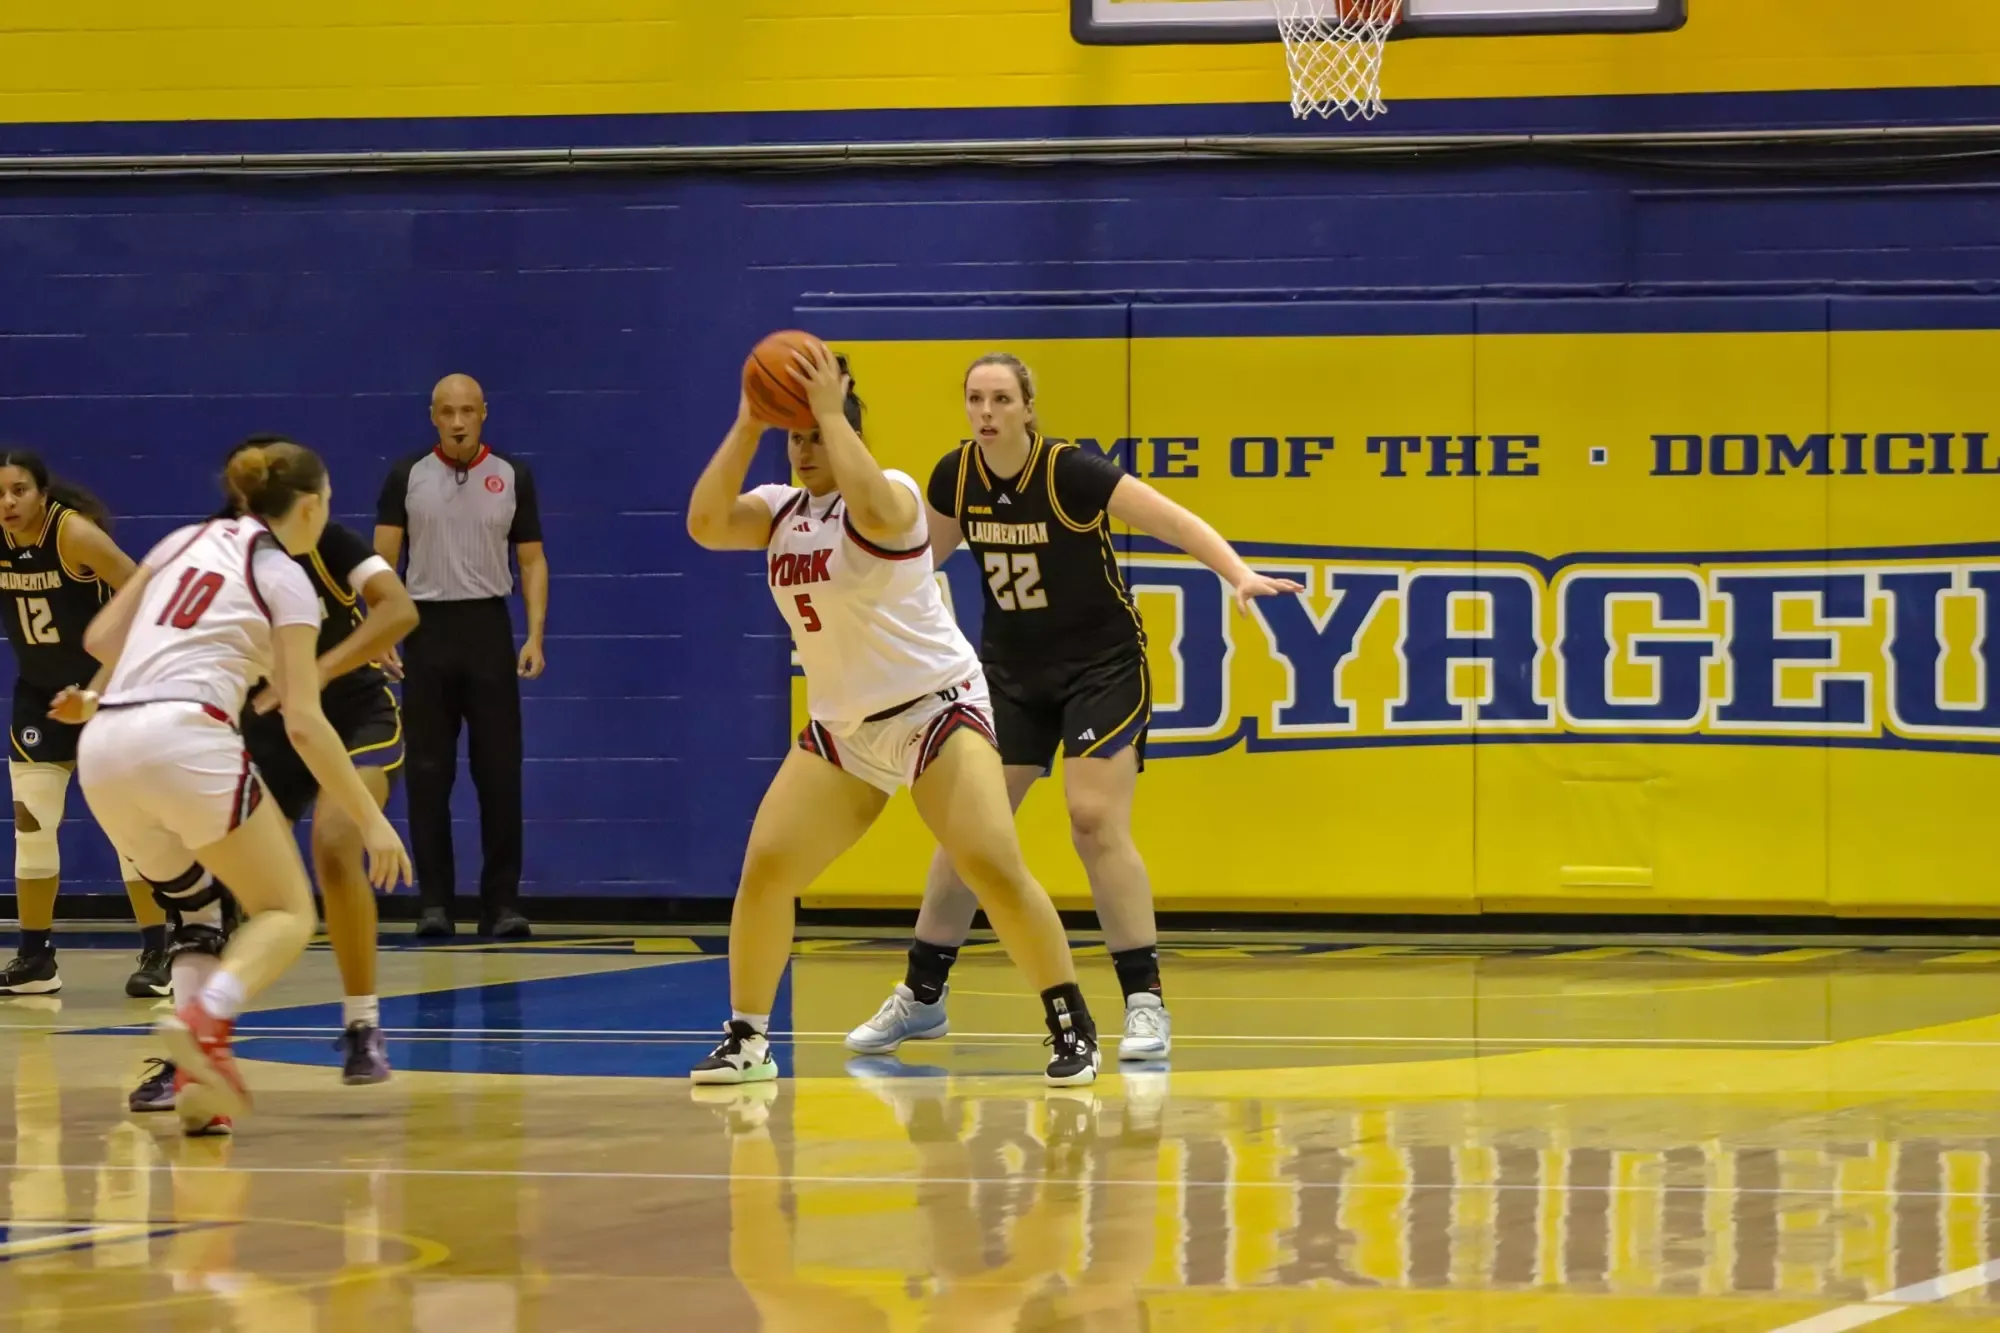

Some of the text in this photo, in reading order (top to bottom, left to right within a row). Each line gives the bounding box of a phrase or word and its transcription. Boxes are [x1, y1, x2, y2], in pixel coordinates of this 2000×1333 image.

[1229, 436, 1335, 479] OF
[1366, 434, 1541, 478] THE
[1649, 432, 2000, 476] DOMICIL
[967, 520, 1050, 546] LAURENTIAN
[0, 570, 62, 592] AURENTIAN
[770, 548, 834, 587] YORK
[983, 551, 1049, 611] 22
[15, 596, 61, 646] 12
[155, 566, 226, 630] 10
[793, 593, 822, 633] 5
[921, 563, 2000, 738] OYAGEU
